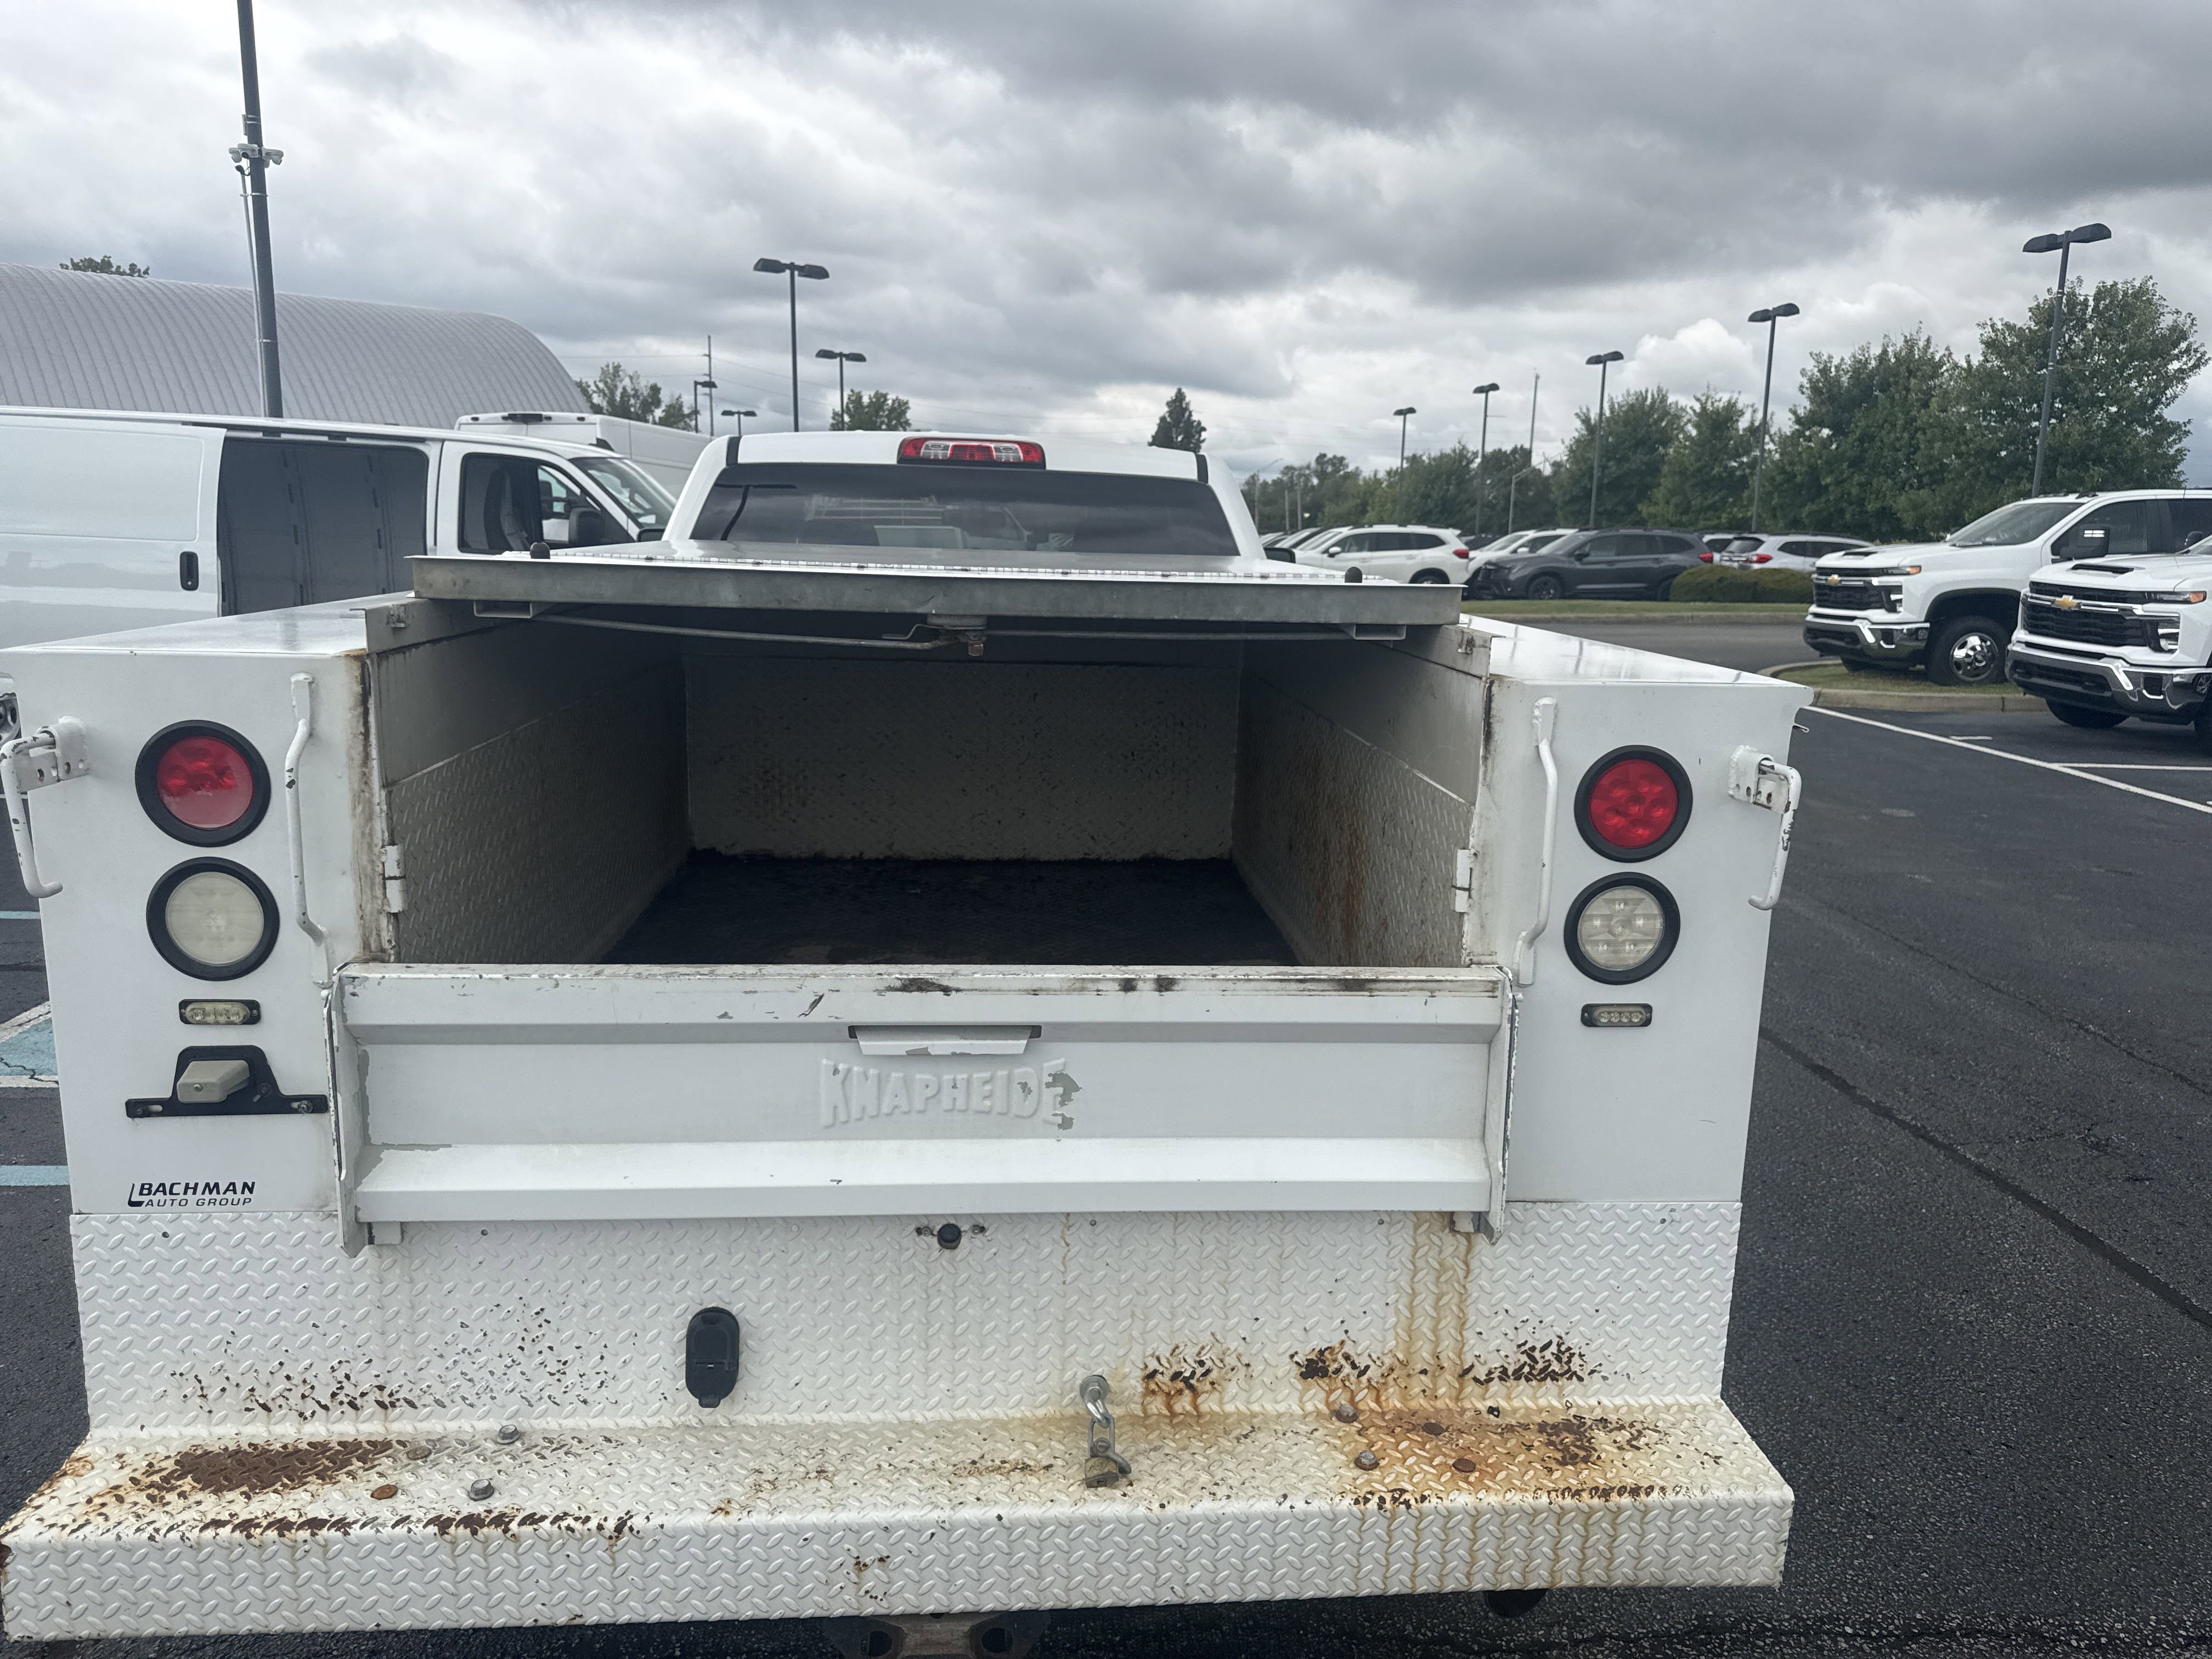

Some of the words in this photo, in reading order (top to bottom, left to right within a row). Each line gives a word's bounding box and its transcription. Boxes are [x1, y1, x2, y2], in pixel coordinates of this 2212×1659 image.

[822, 1058, 1069, 1128] KNAPHEIDE
[138, 1181, 256, 1196] BACHMAN
[145, 1198, 189, 1207] AUTO
[196, 1198, 252, 1206] GROUP
